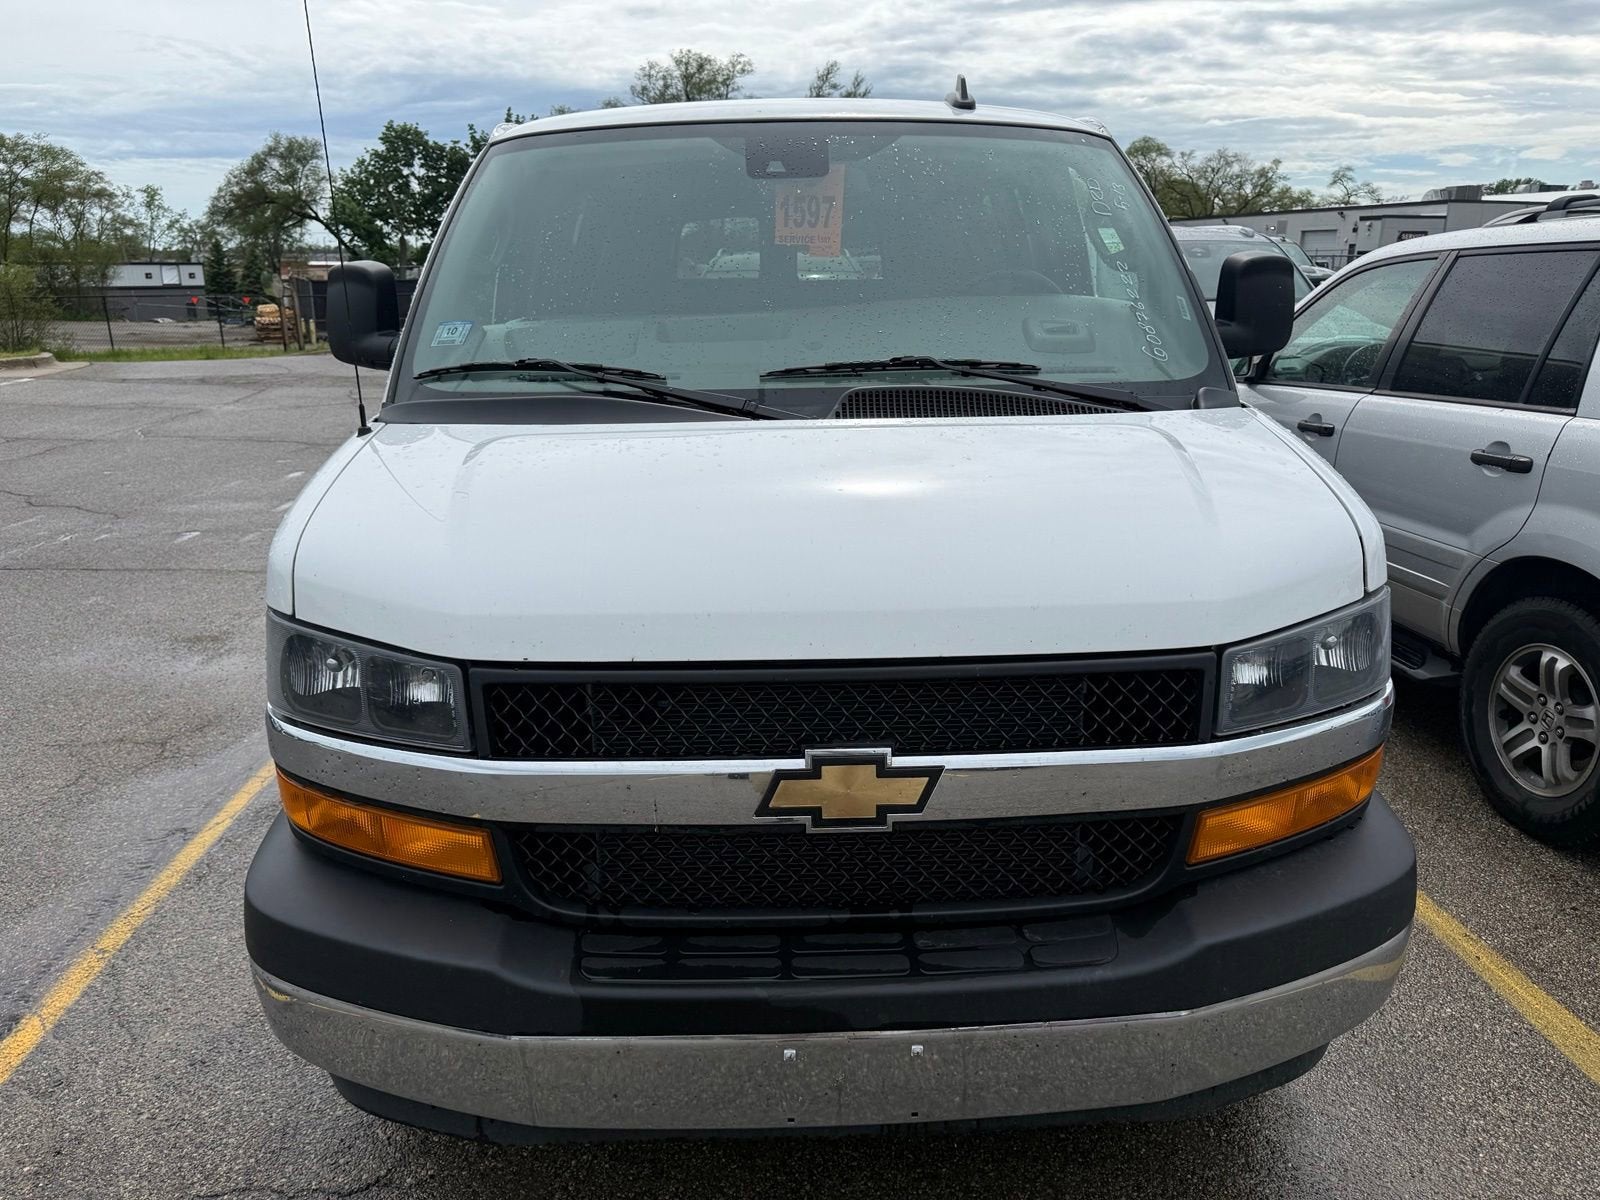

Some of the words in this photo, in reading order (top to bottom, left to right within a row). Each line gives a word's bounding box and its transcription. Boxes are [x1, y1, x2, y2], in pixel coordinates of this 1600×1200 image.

[780, 194, 836, 229] 1597
[778, 234, 816, 244] SERVICE
[446, 327, 458, 336] 10
